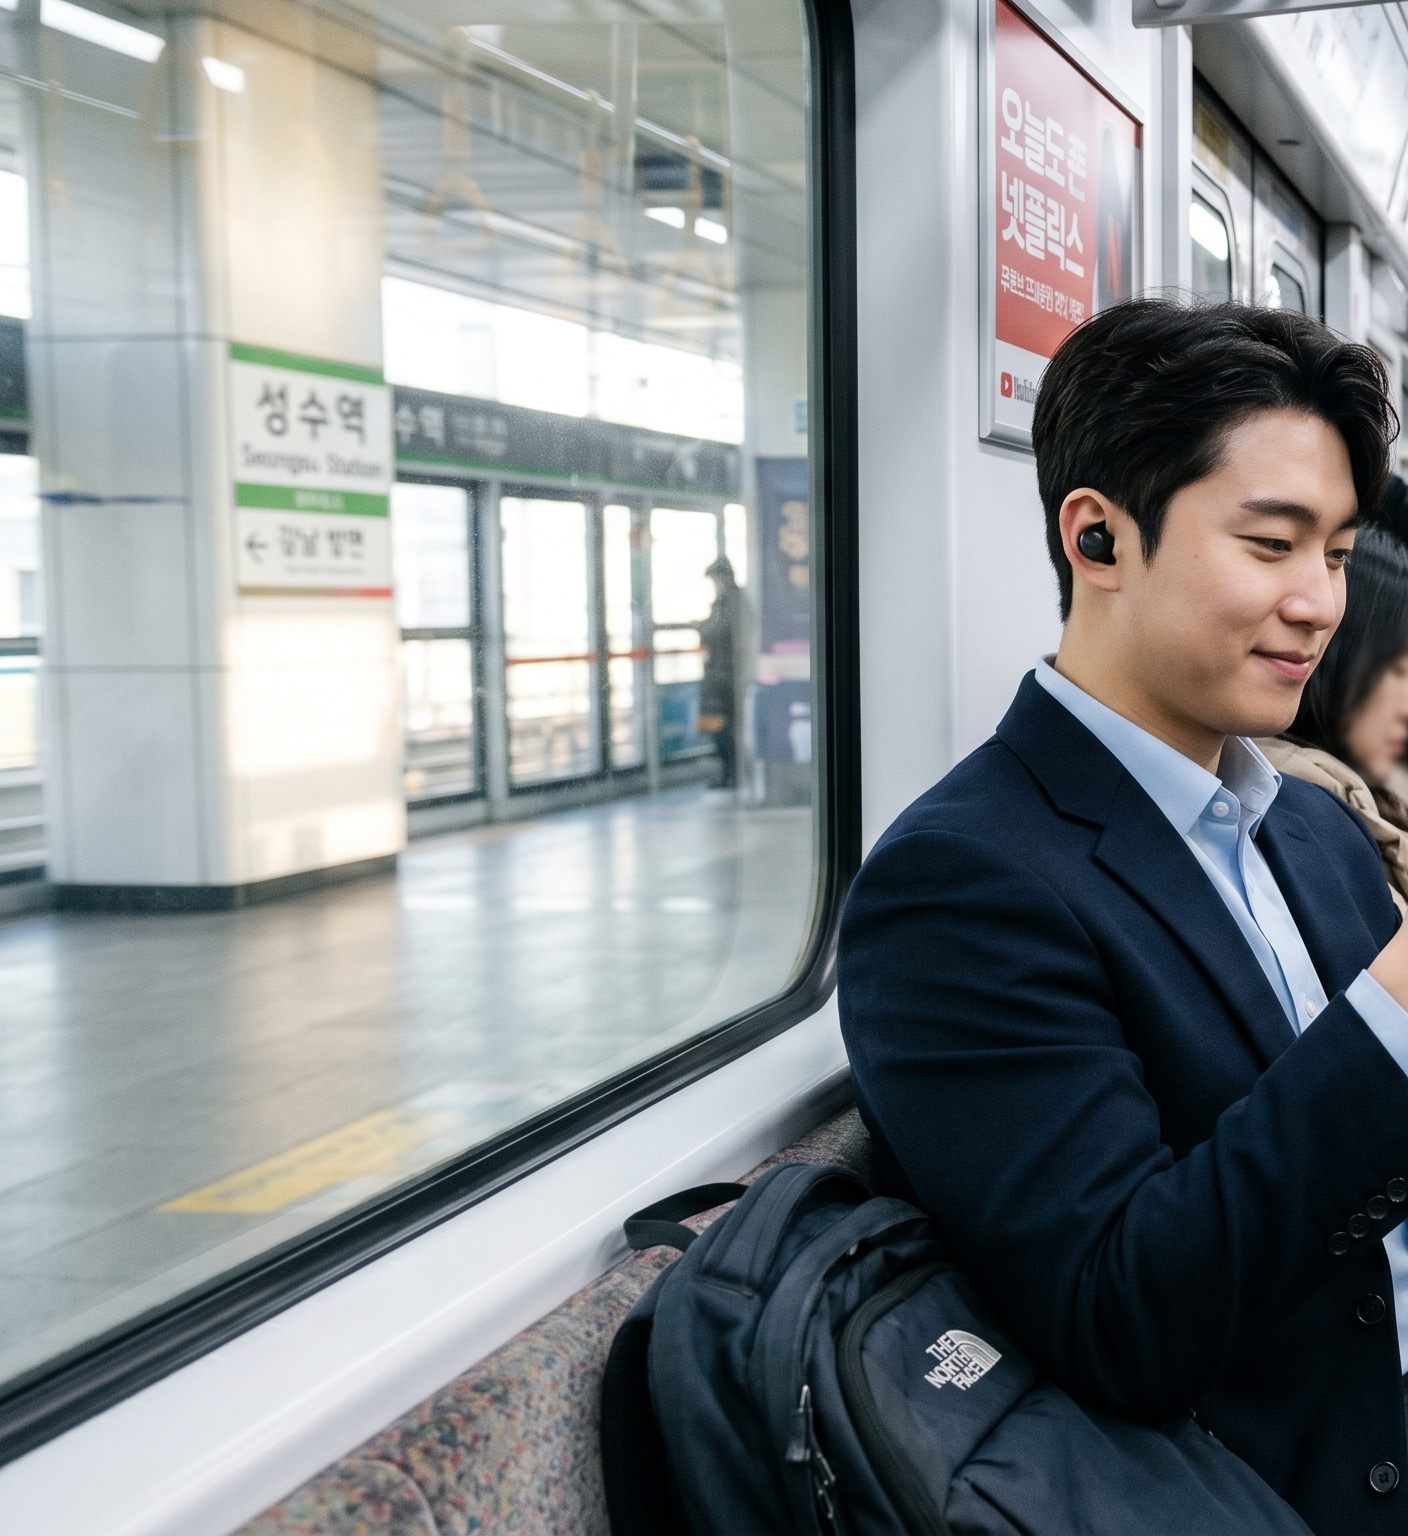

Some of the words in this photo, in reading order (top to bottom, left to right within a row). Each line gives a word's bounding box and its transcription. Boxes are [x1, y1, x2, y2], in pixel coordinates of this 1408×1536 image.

[1001, 87, 1065, 188] 오늘도
[1001, 170, 1084, 278] 넷플릭스
[257, 383, 367, 446] 성수역
[924, 1347, 971, 1389] NORTH
[925, 1333, 957, 1361] THE
[951, 1357, 985, 1391] FACE
